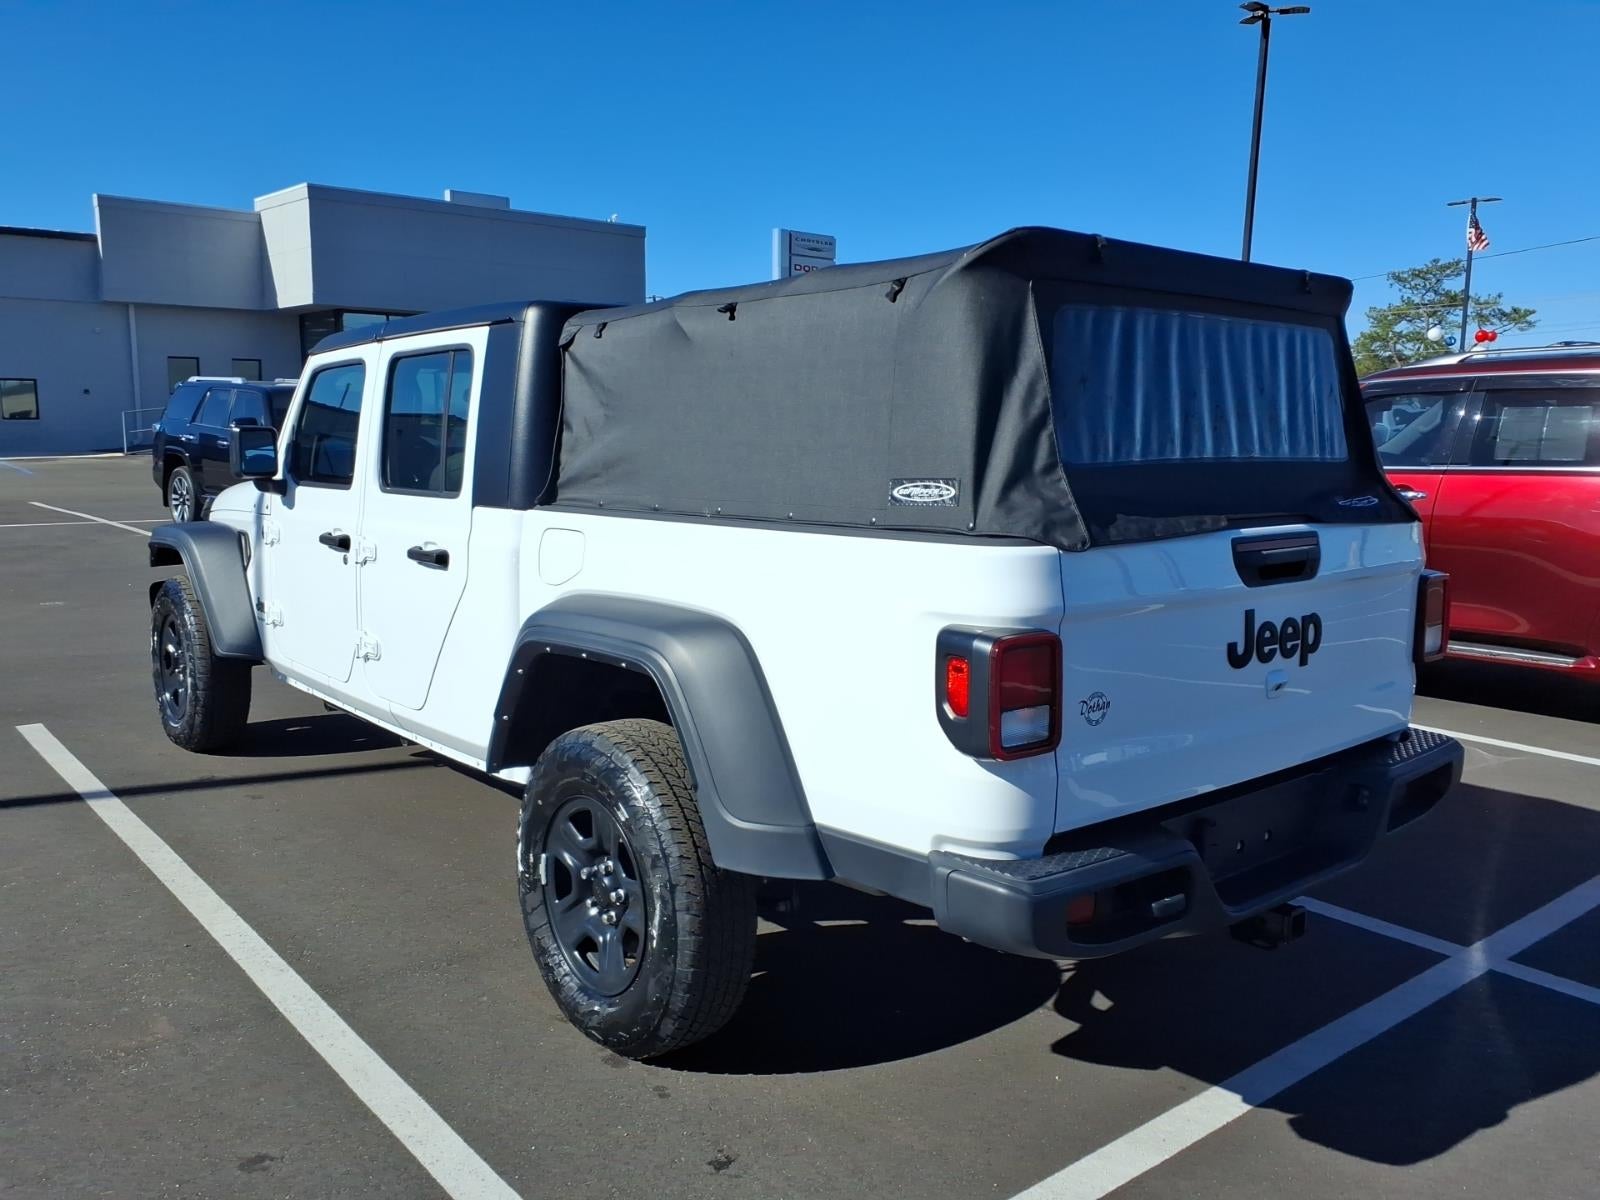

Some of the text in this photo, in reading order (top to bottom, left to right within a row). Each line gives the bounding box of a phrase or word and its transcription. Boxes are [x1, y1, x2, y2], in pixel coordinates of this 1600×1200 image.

[794, 236, 833, 246] CHRYSLER
[794, 263, 818, 273] DOD
[1227, 608, 1322, 669] Jeep
[1078, 699, 1111, 716] Dothan
